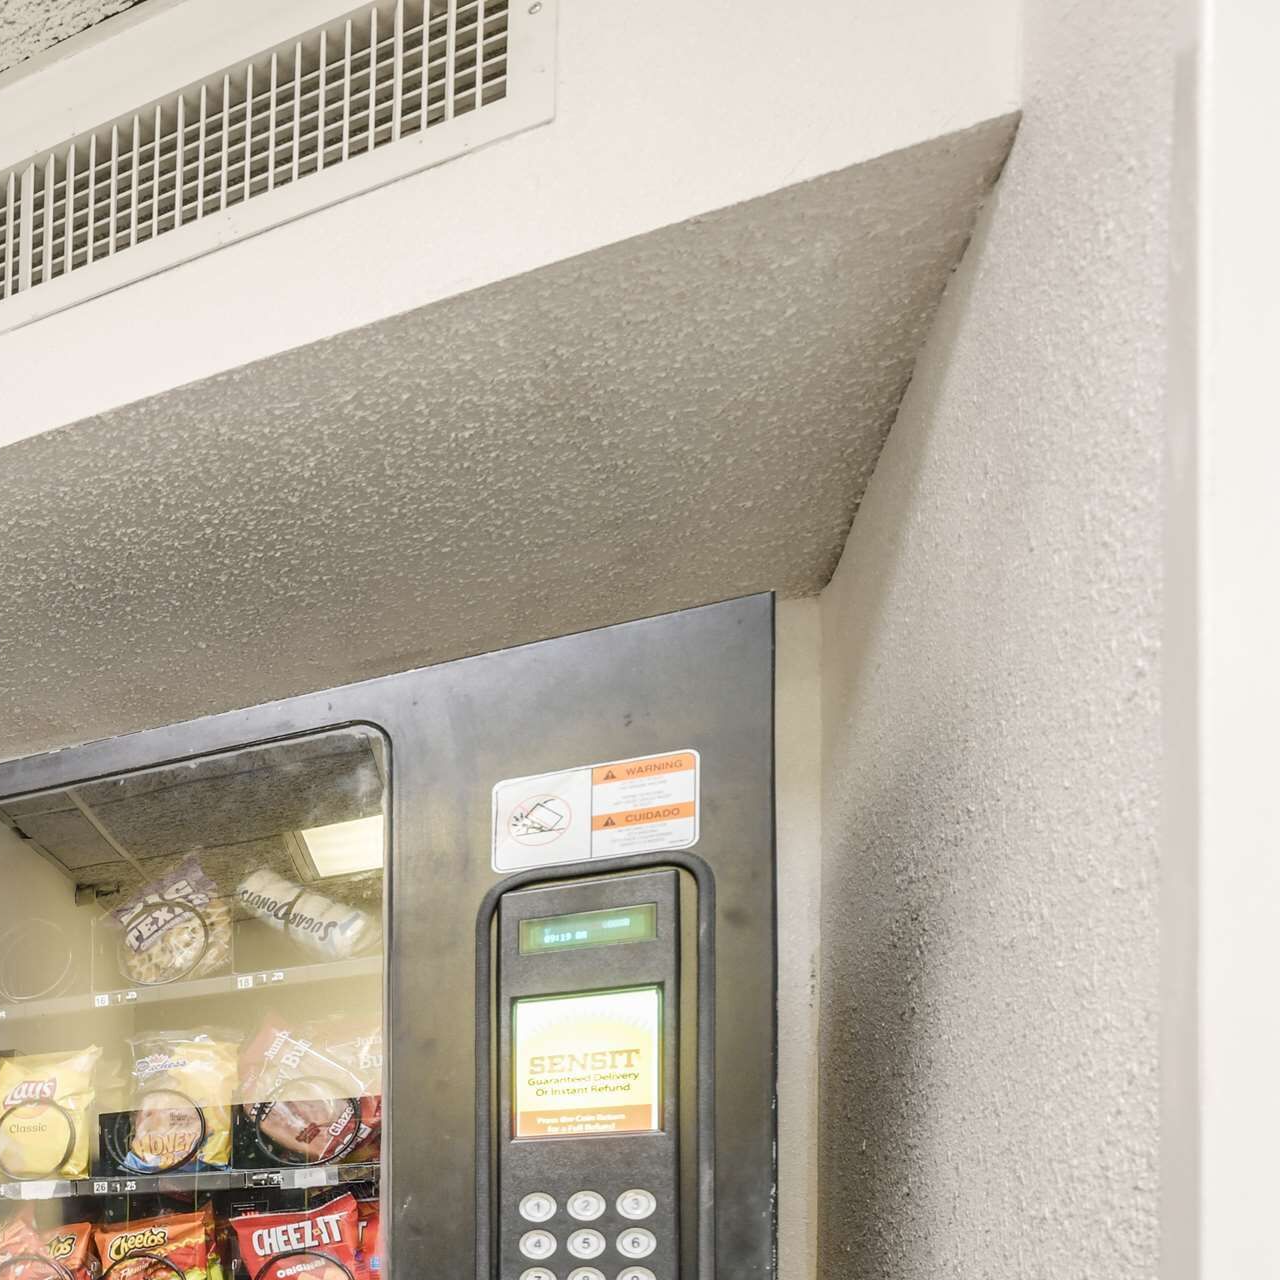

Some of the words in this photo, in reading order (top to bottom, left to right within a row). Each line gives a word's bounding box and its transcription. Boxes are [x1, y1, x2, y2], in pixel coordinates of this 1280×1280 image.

[625, 759, 683, 777] WARNING
[624, 807, 681, 823] CUIDADO
[126, 893, 209, 953] TEXS
[290, 910, 338, 942] SUGAR
[528, 1048, 641, 1075] SENSIT
[527, 1074, 592, 1087] Guaranteed
[594, 1071, 640, 1082] Delivery
[535, 1088, 548, 1097] Or
[551, 1086, 589, 1097] Instant
[590, 1083, 632, 1093] Refund
[329, 1101, 357, 1136] Glaze
[9, 1122, 47, 1134] Classic
[95, 1183, 106, 1192] 26
[582, 1200, 590, 1212] 2
[631, 1198, 640, 1210] 3
[109, 1229, 167, 1261] Cheetos
[533, 1239, 542, 1250] 4
[582, 1238, 590, 1250] 5
[631, 1237, 640, 1249] 6
